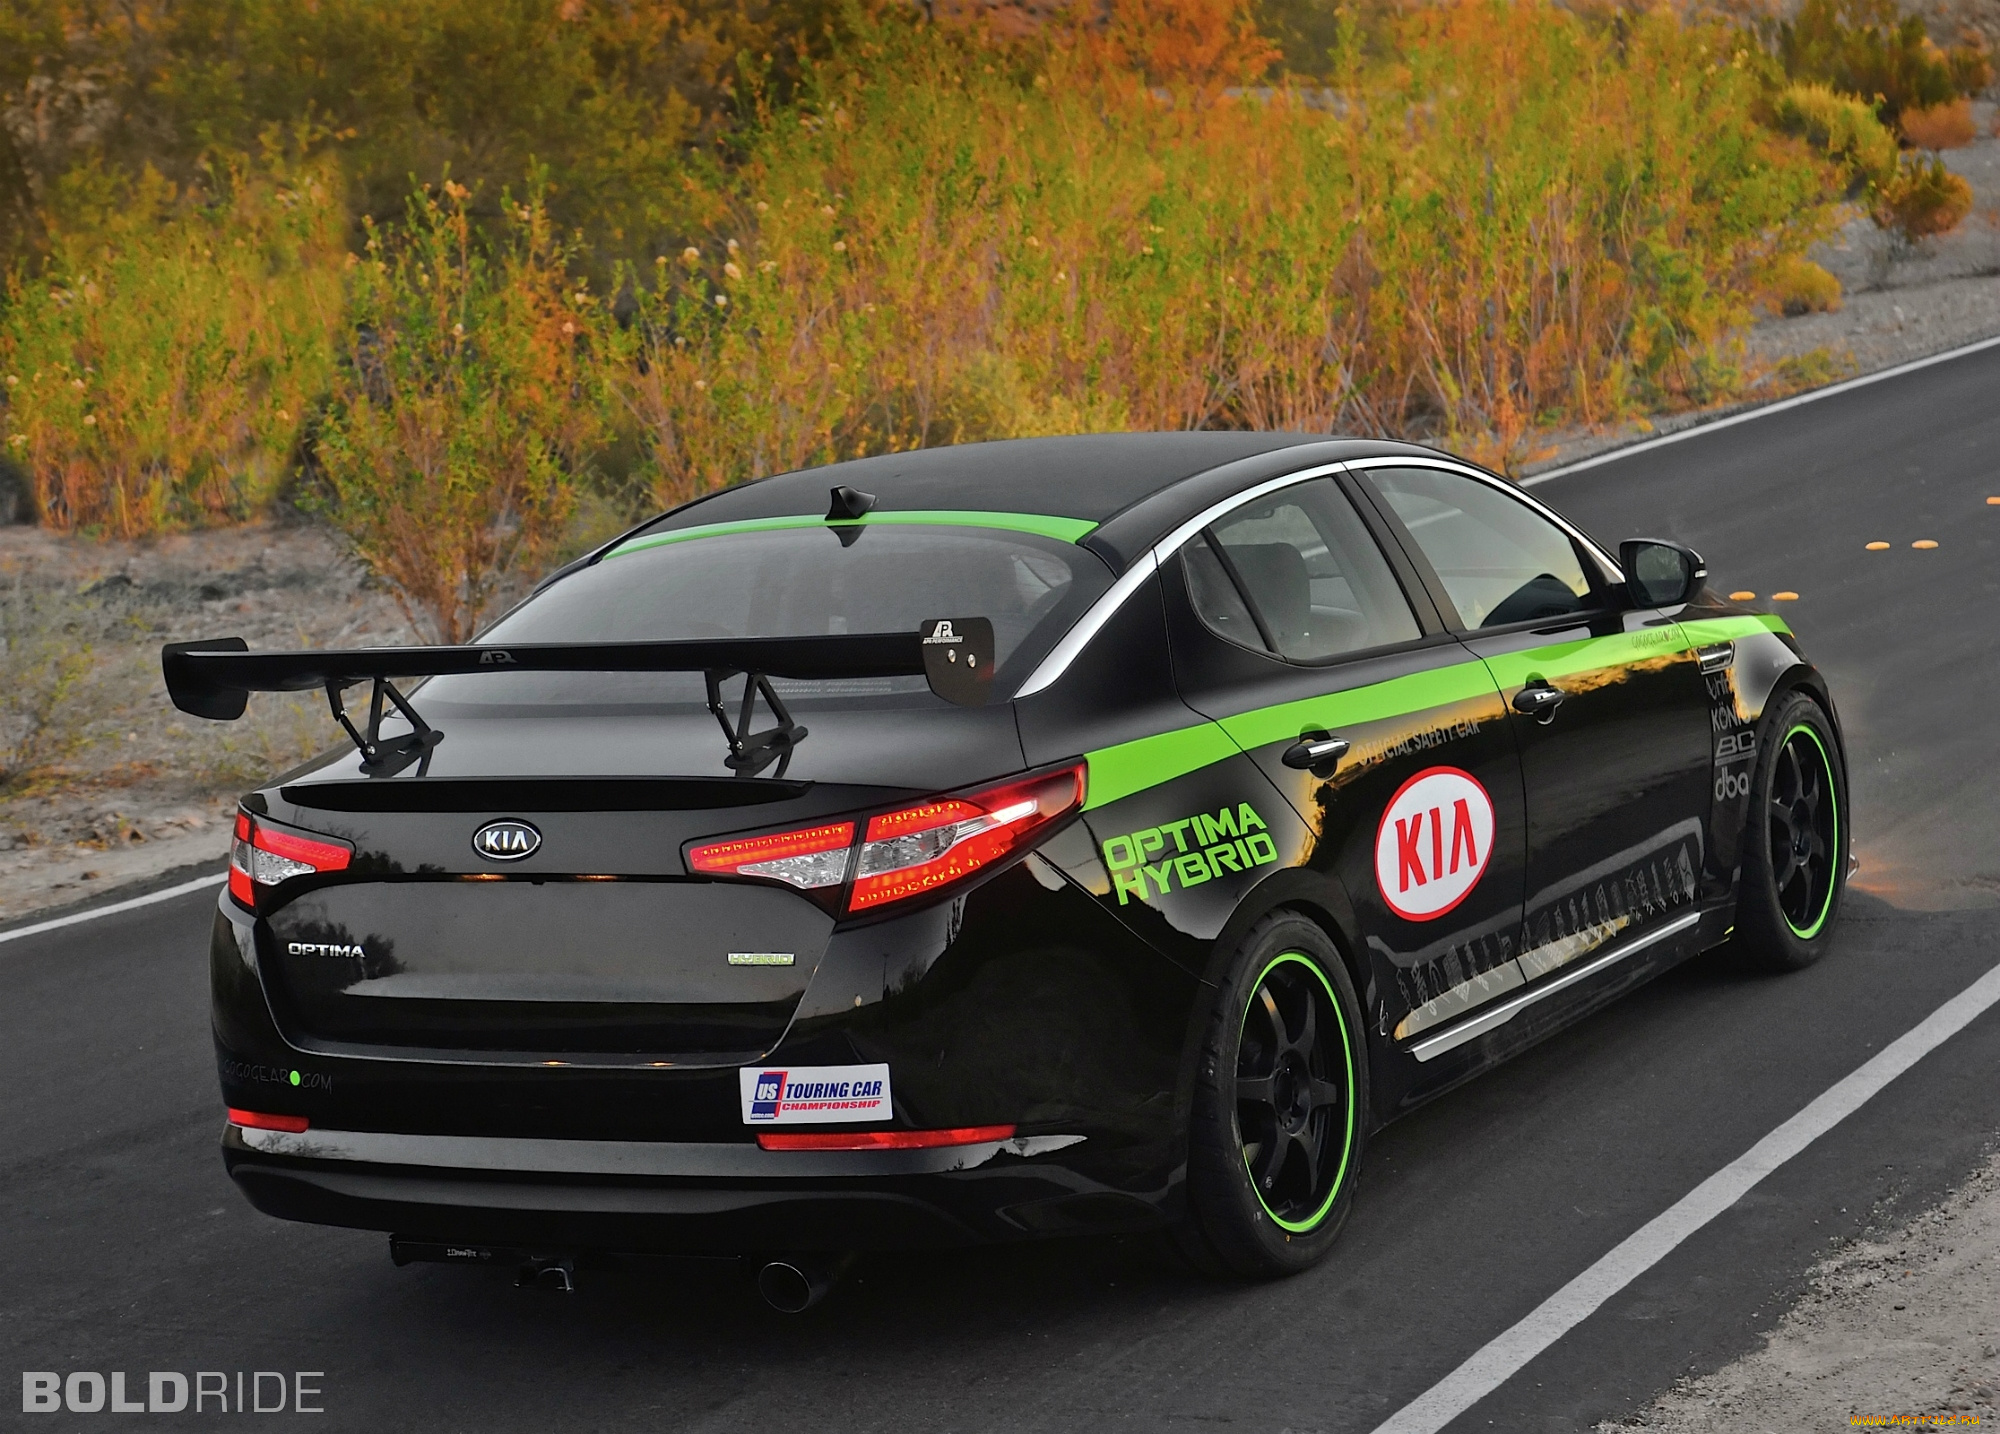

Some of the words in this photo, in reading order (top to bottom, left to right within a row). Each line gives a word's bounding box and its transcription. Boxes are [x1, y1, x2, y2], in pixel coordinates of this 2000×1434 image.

[1356, 732, 1413, 766] OFFICIAL
[1412, 724, 1454, 751] SAFETY
[1455, 717, 1481, 739] CAR
[1715, 730, 1756, 758] BC
[1715, 766, 1749, 802] dba
[485, 831, 528, 851] KIA
[1103, 802, 1268, 871] OPTIMA
[1395, 798, 1478, 893] KIA
[1113, 832, 1278, 906] HYBRID
[288, 942, 366, 958] OPTIMA
[729, 953, 794, 965] HYBRID
[757, 1083, 779, 1100] US
[786, 1082, 849, 1099] TOURING
[852, 1081, 882, 1097] CAR
[781, 1100, 881, 1111] CHAMPIONSHIP
